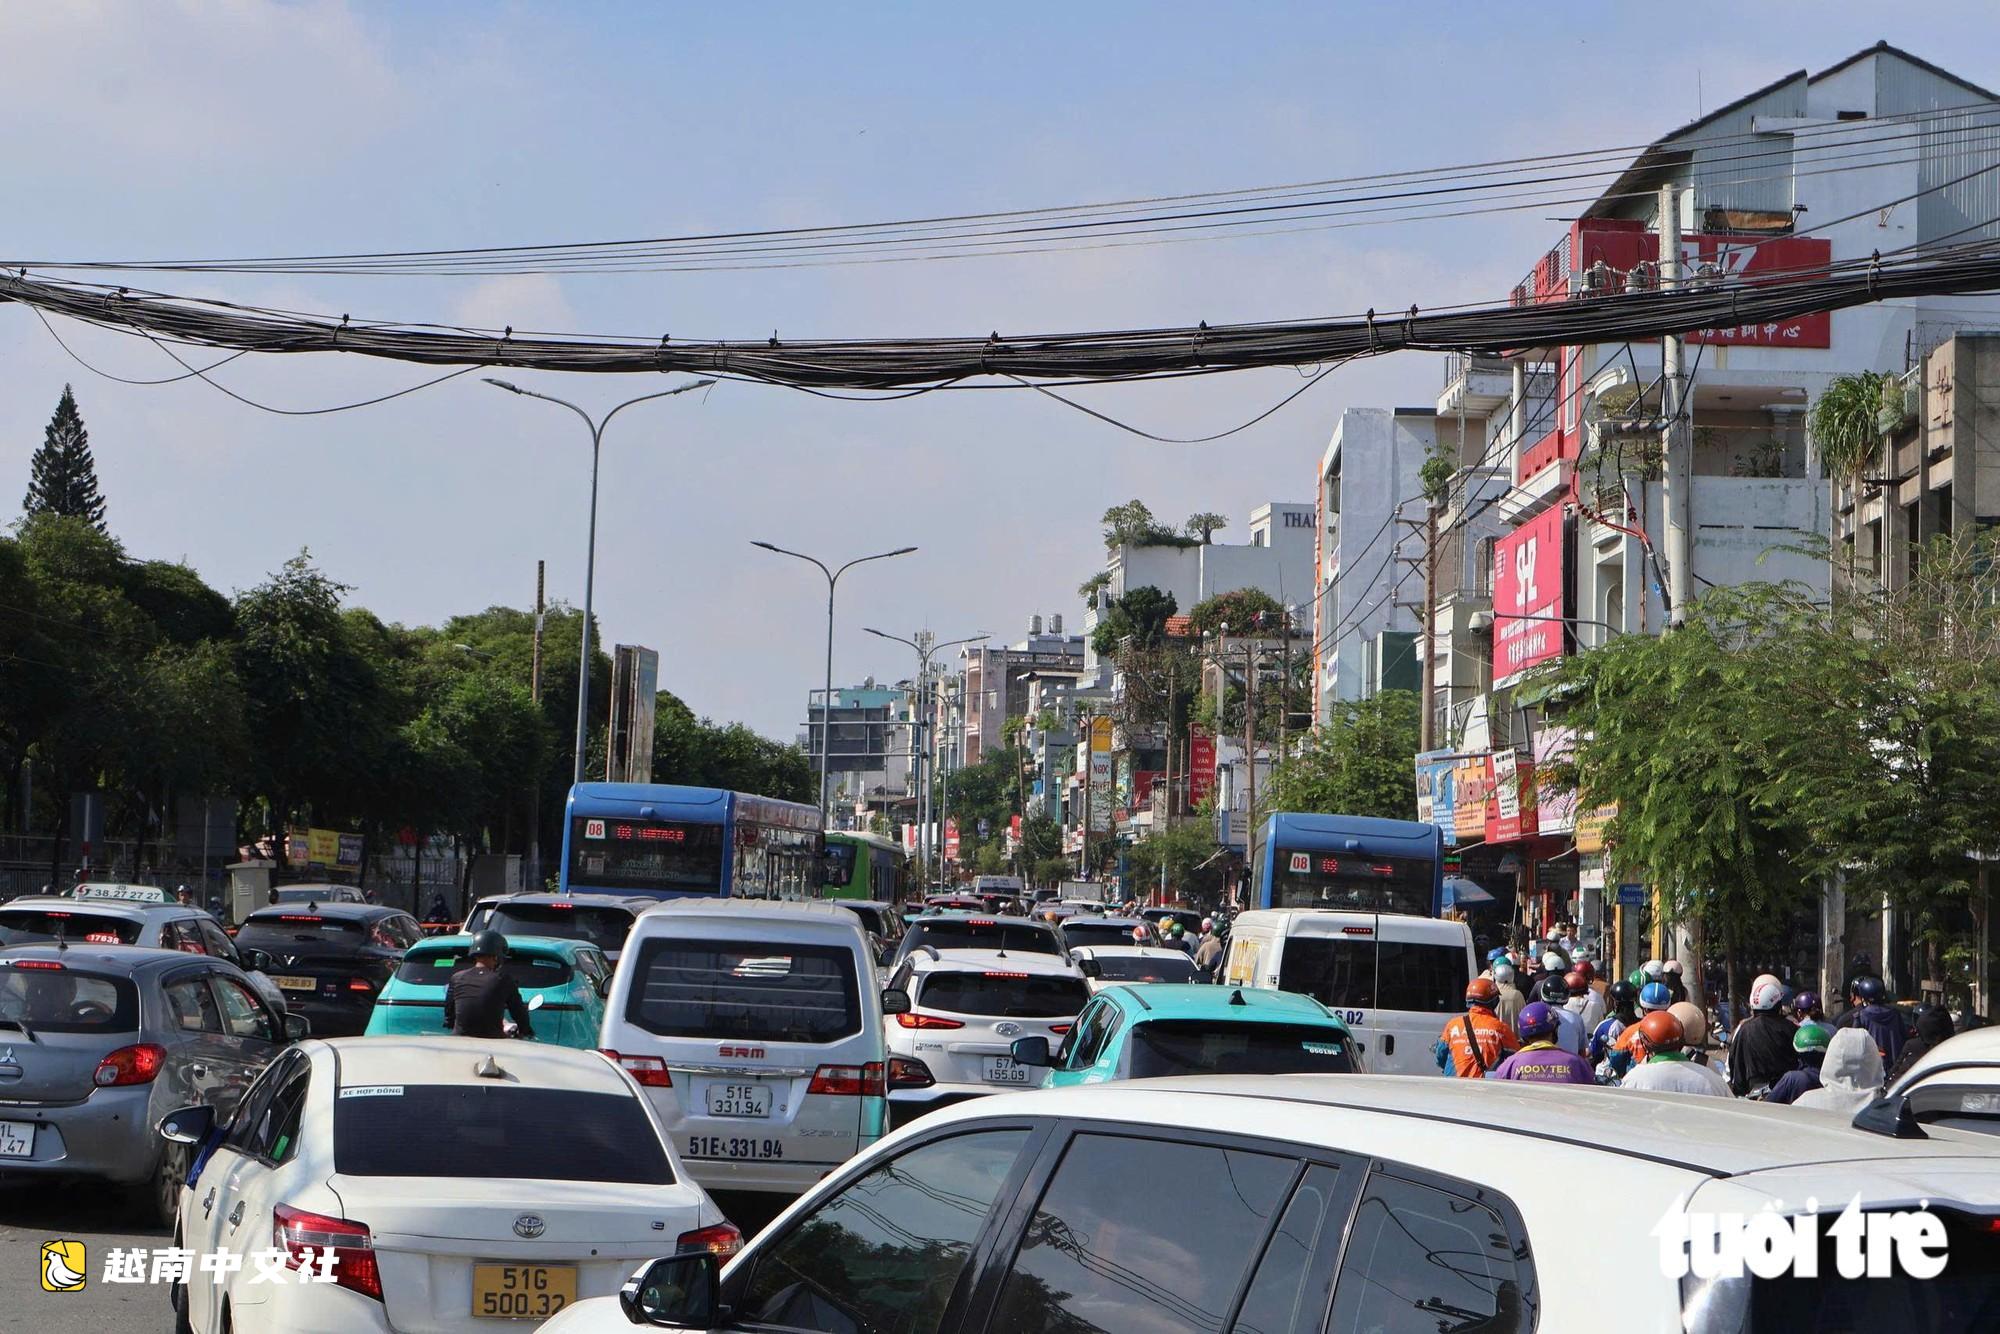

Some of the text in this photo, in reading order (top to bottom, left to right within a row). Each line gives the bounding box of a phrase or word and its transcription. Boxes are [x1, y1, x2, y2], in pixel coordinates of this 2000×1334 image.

[588, 824, 603, 836] 08
[1293, 857, 1308, 870] 08
[130, 891, 144, 899] 27
[719, 1046, 765, 1059] SRM
[996, 1058, 1017, 1069] 67A
[988, 1069, 1025, 1081] 155.09
[726, 1086, 752, 1099] 51E
[714, 1100, 762, 1115] 331.94
[0, 1124, 15, 1138] 1L
[0, 1138, 25, 1153] .47
[689, 1136, 783, 1159] 51E 331.94
[503, 1268, 547, 1290] 51G
[483, 1293, 566, 1315] 500.32
